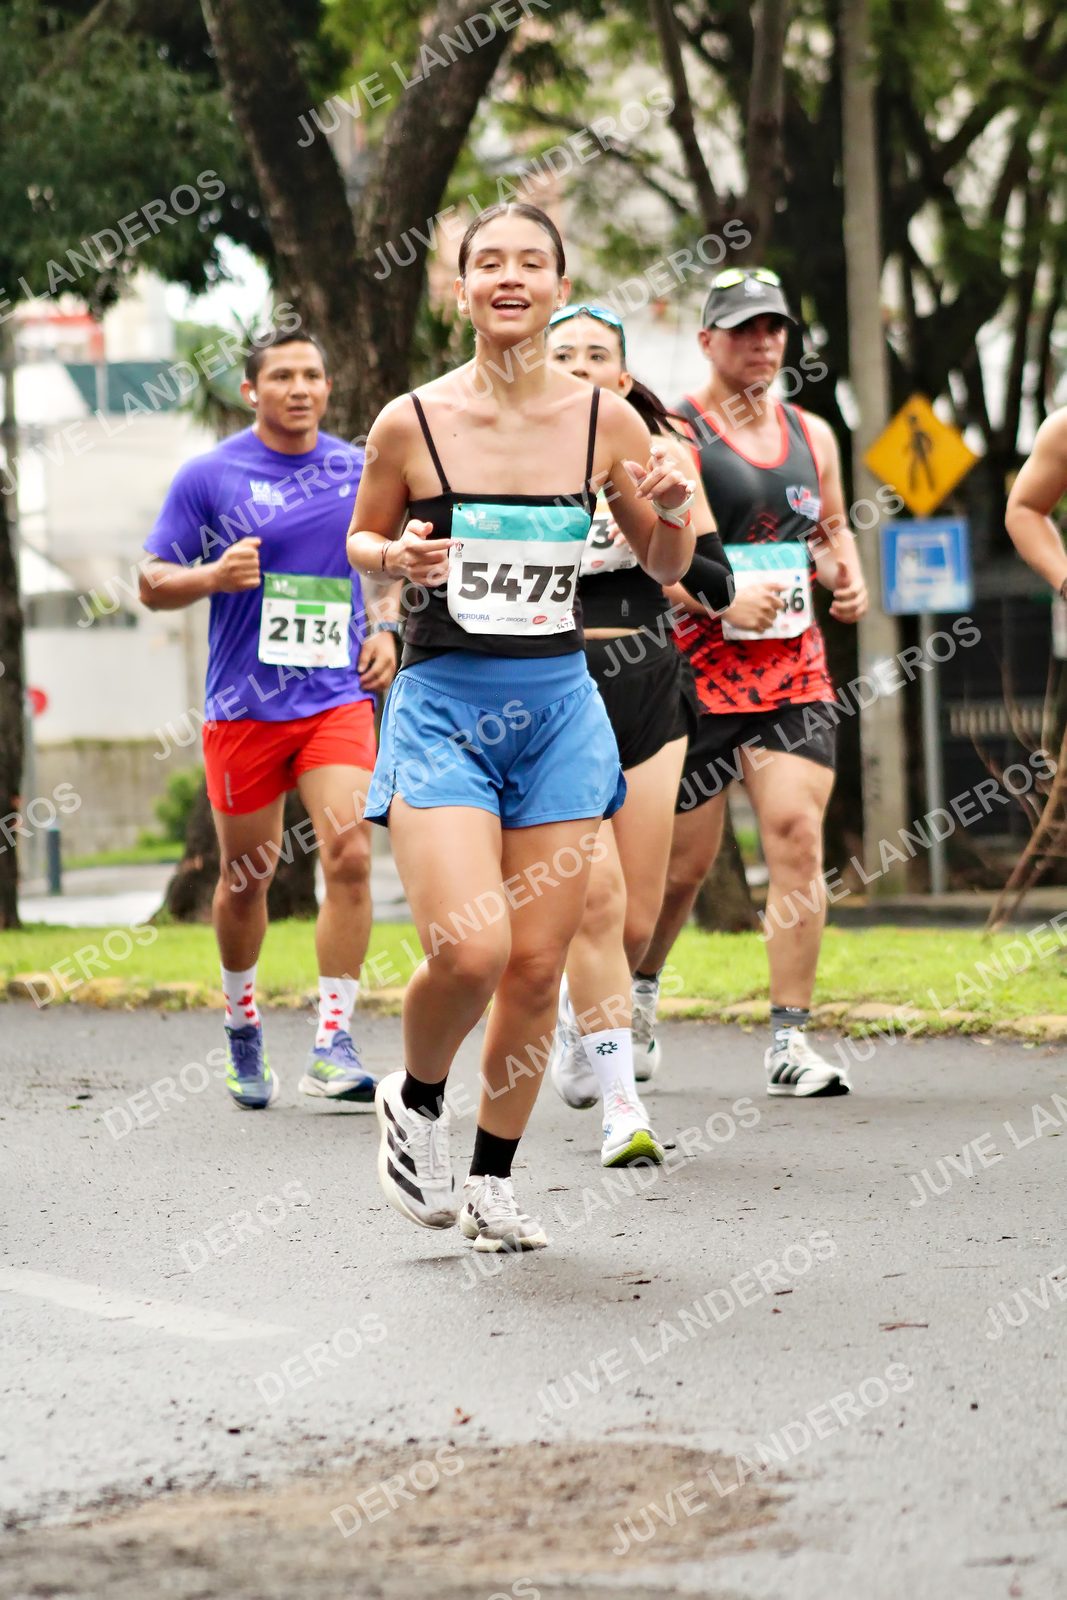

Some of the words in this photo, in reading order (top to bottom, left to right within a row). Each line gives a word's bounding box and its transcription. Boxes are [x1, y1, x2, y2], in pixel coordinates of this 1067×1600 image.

[458, 561, 576, 603] 5473
[777, 587, 805, 614] 6
[457, 612, 490, 621] PERDURA
[267, 616, 342, 646] 2134
